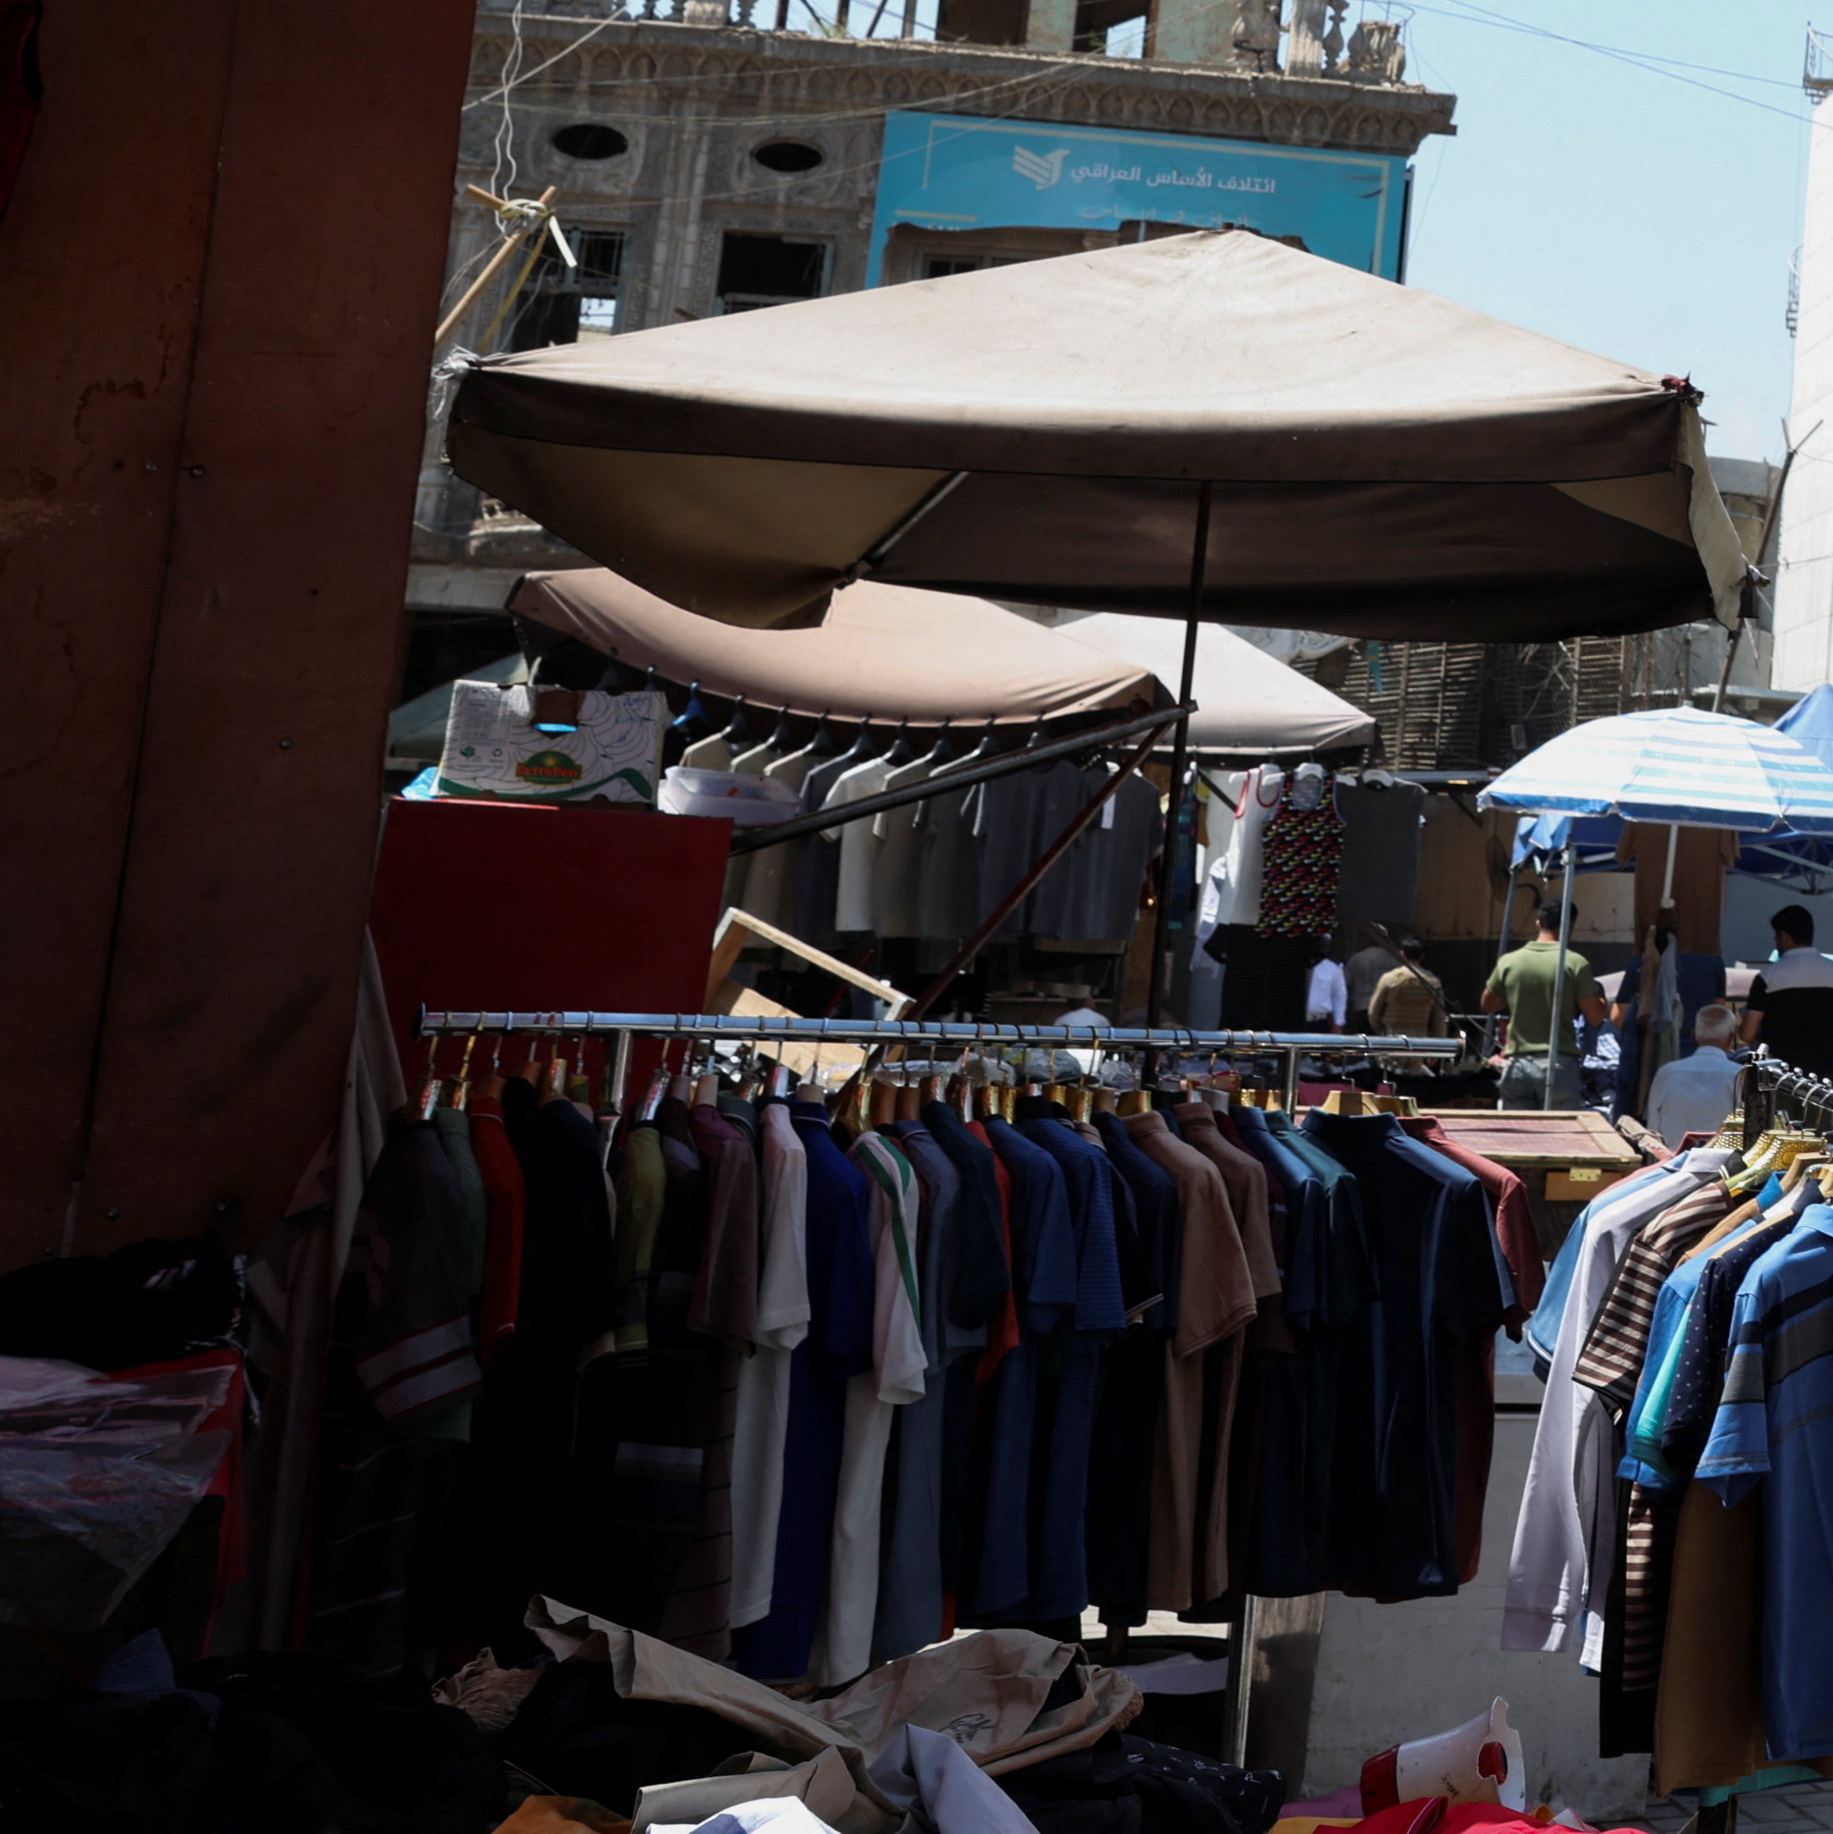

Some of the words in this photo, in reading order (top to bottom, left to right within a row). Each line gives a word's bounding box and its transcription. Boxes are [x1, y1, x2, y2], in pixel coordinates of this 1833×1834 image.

[1070, 164, 1141, 183] العراقي
[1146, 167, 1213, 188] الأساس
[1217, 176, 1276, 194] ائتلاف
